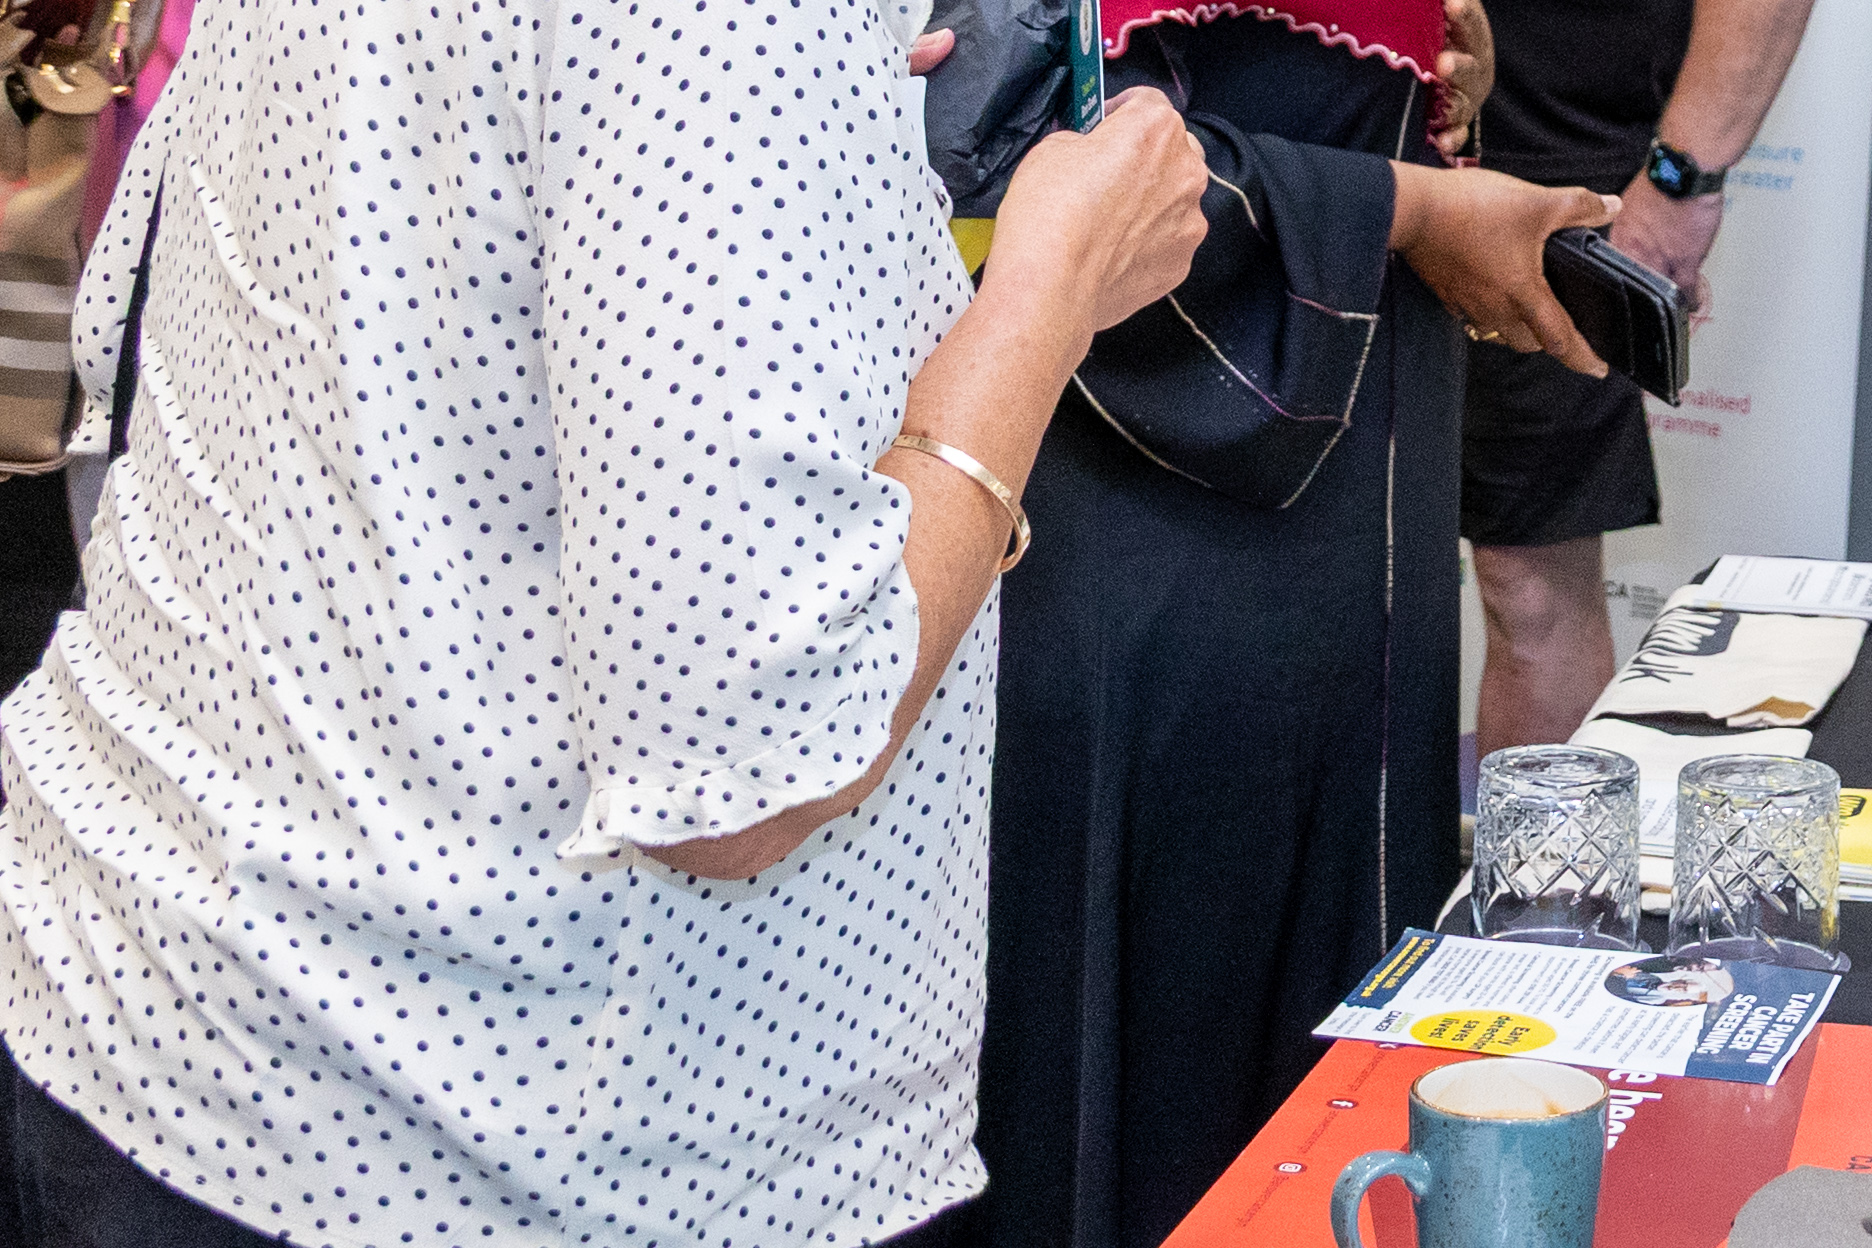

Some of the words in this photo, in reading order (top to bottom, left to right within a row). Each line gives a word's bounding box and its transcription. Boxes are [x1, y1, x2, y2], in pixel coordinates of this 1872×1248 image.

[1774, 992, 1815, 1024] TAKE
[1373, 1010, 1402, 1032] CANCER
[1427, 1018, 1459, 1039] lives!
[1451, 1020, 1480, 1042] saves
[1467, 1015, 1513, 1051] detection
[1695, 994, 1758, 1055] SCREENING
[1728, 1006, 1777, 1050] CANCER
[1499, 1026, 1531, 1046] Early
[1755, 1024, 1795, 1052] PART
[1745, 1053, 1774, 1064] IN
